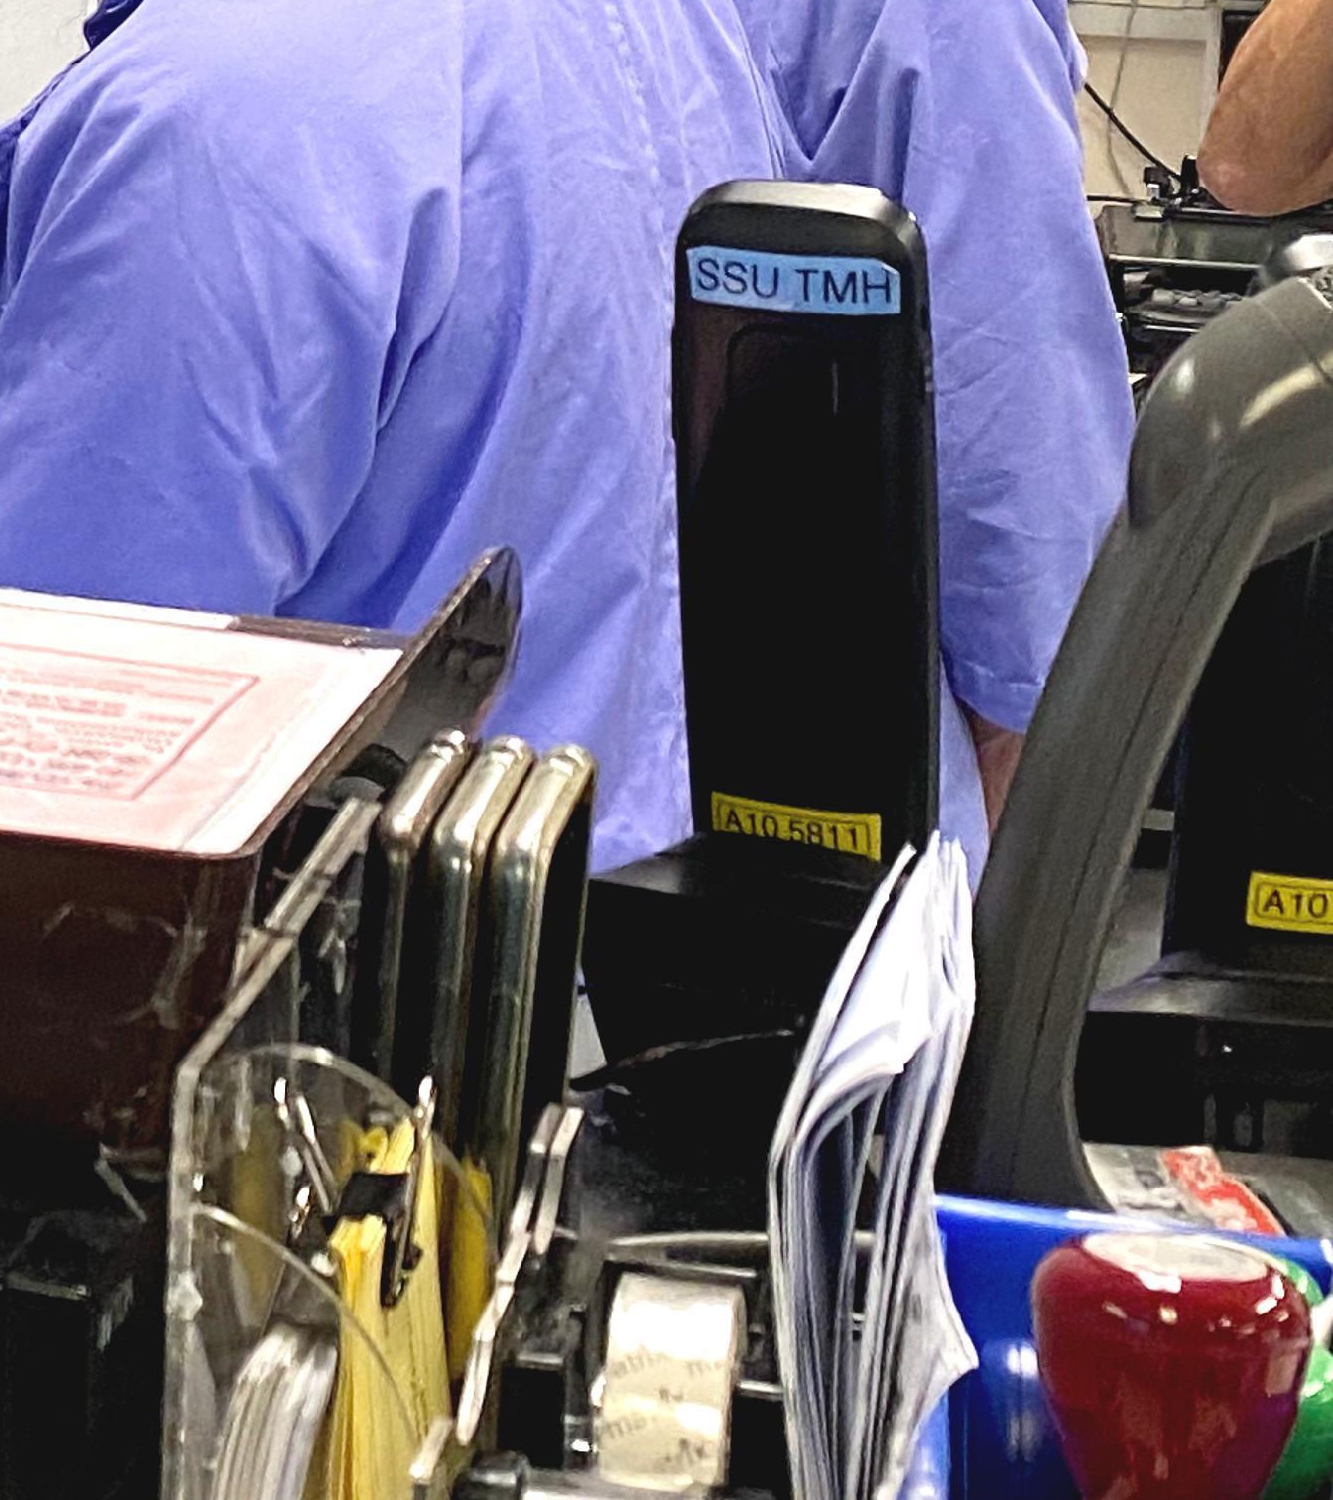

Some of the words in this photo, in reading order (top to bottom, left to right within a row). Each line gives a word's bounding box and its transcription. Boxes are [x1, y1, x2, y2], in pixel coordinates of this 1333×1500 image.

[697, 257, 779, 299] SSU
[795, 268, 893, 304] TMH
[724, 809, 778, 837] A10
[789, 819, 859, 850] 5811
[1262, 889, 1330, 918] A10
